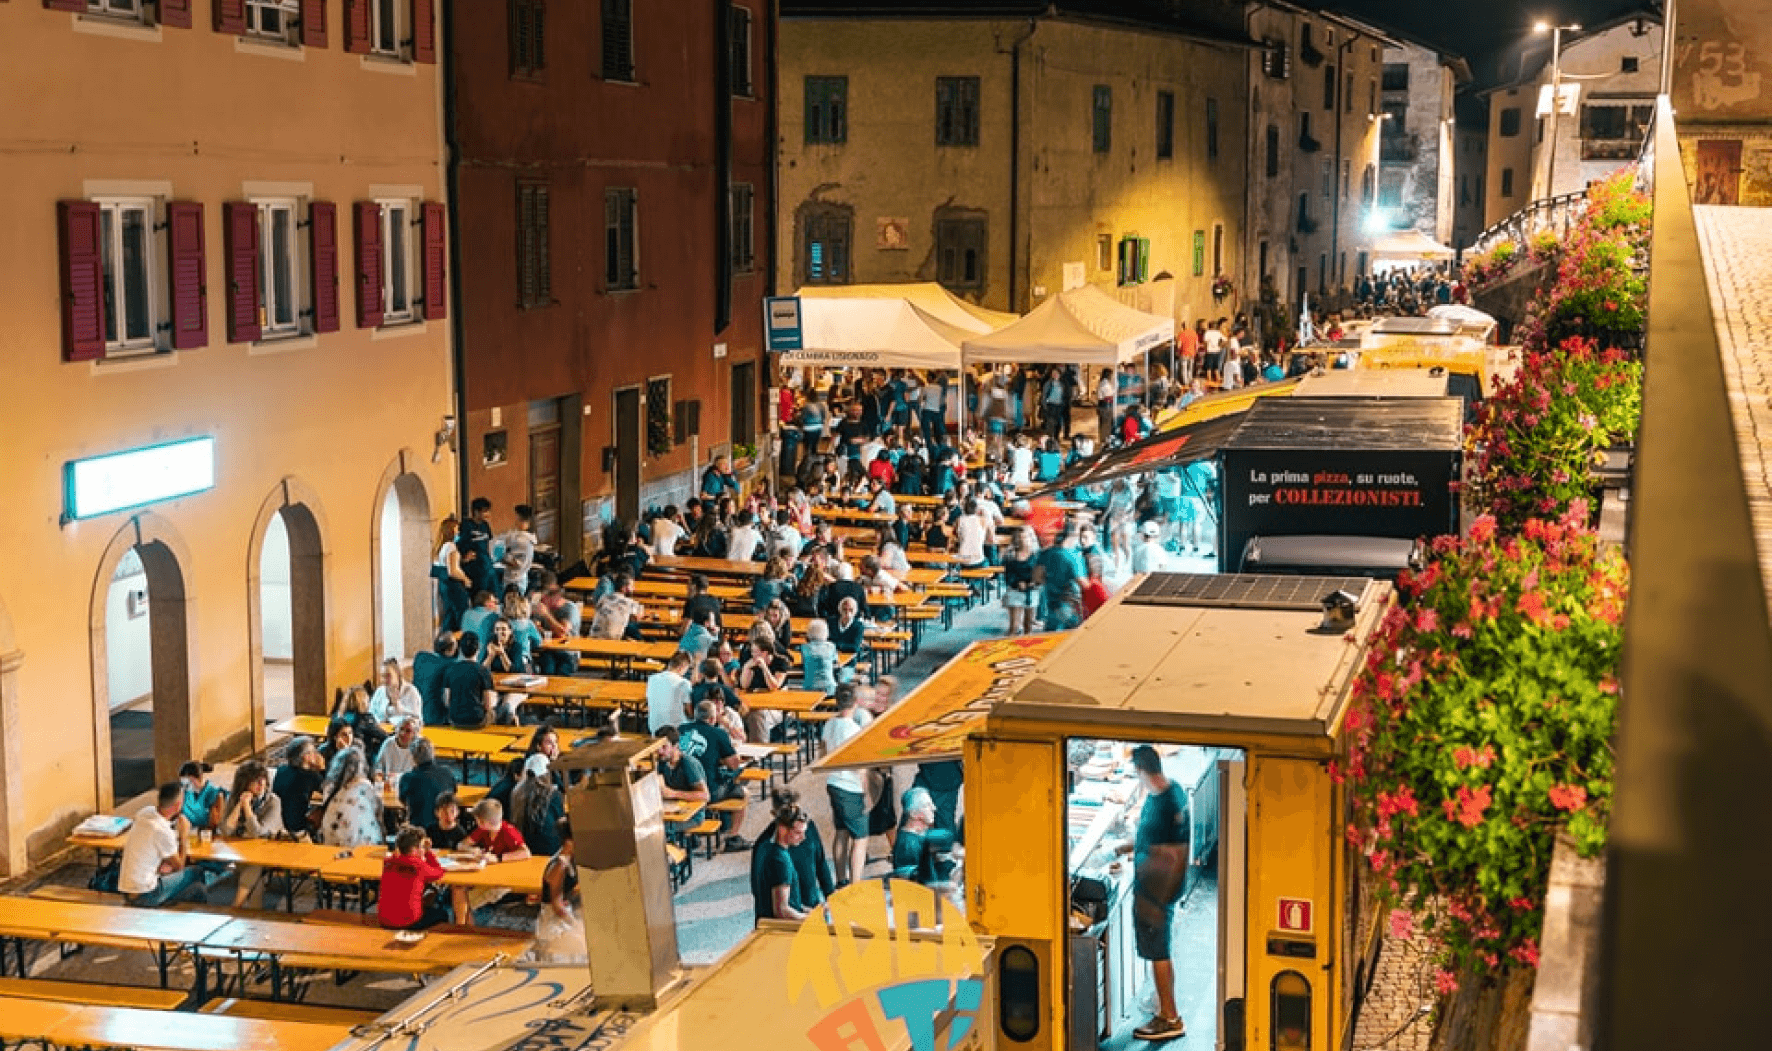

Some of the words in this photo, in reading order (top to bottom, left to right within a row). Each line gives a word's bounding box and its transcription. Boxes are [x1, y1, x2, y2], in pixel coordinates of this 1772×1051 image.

[1250, 469, 1267, 483] La
[1270, 469, 1310, 485] prima
[1313, 470, 1352, 485] pizza,
[1356, 473, 1373, 484] su
[1377, 471, 1418, 486] ruote,
[1248, 492, 1271, 506] per
[1273, 488, 1425, 507] COLLEZIONISTI.
